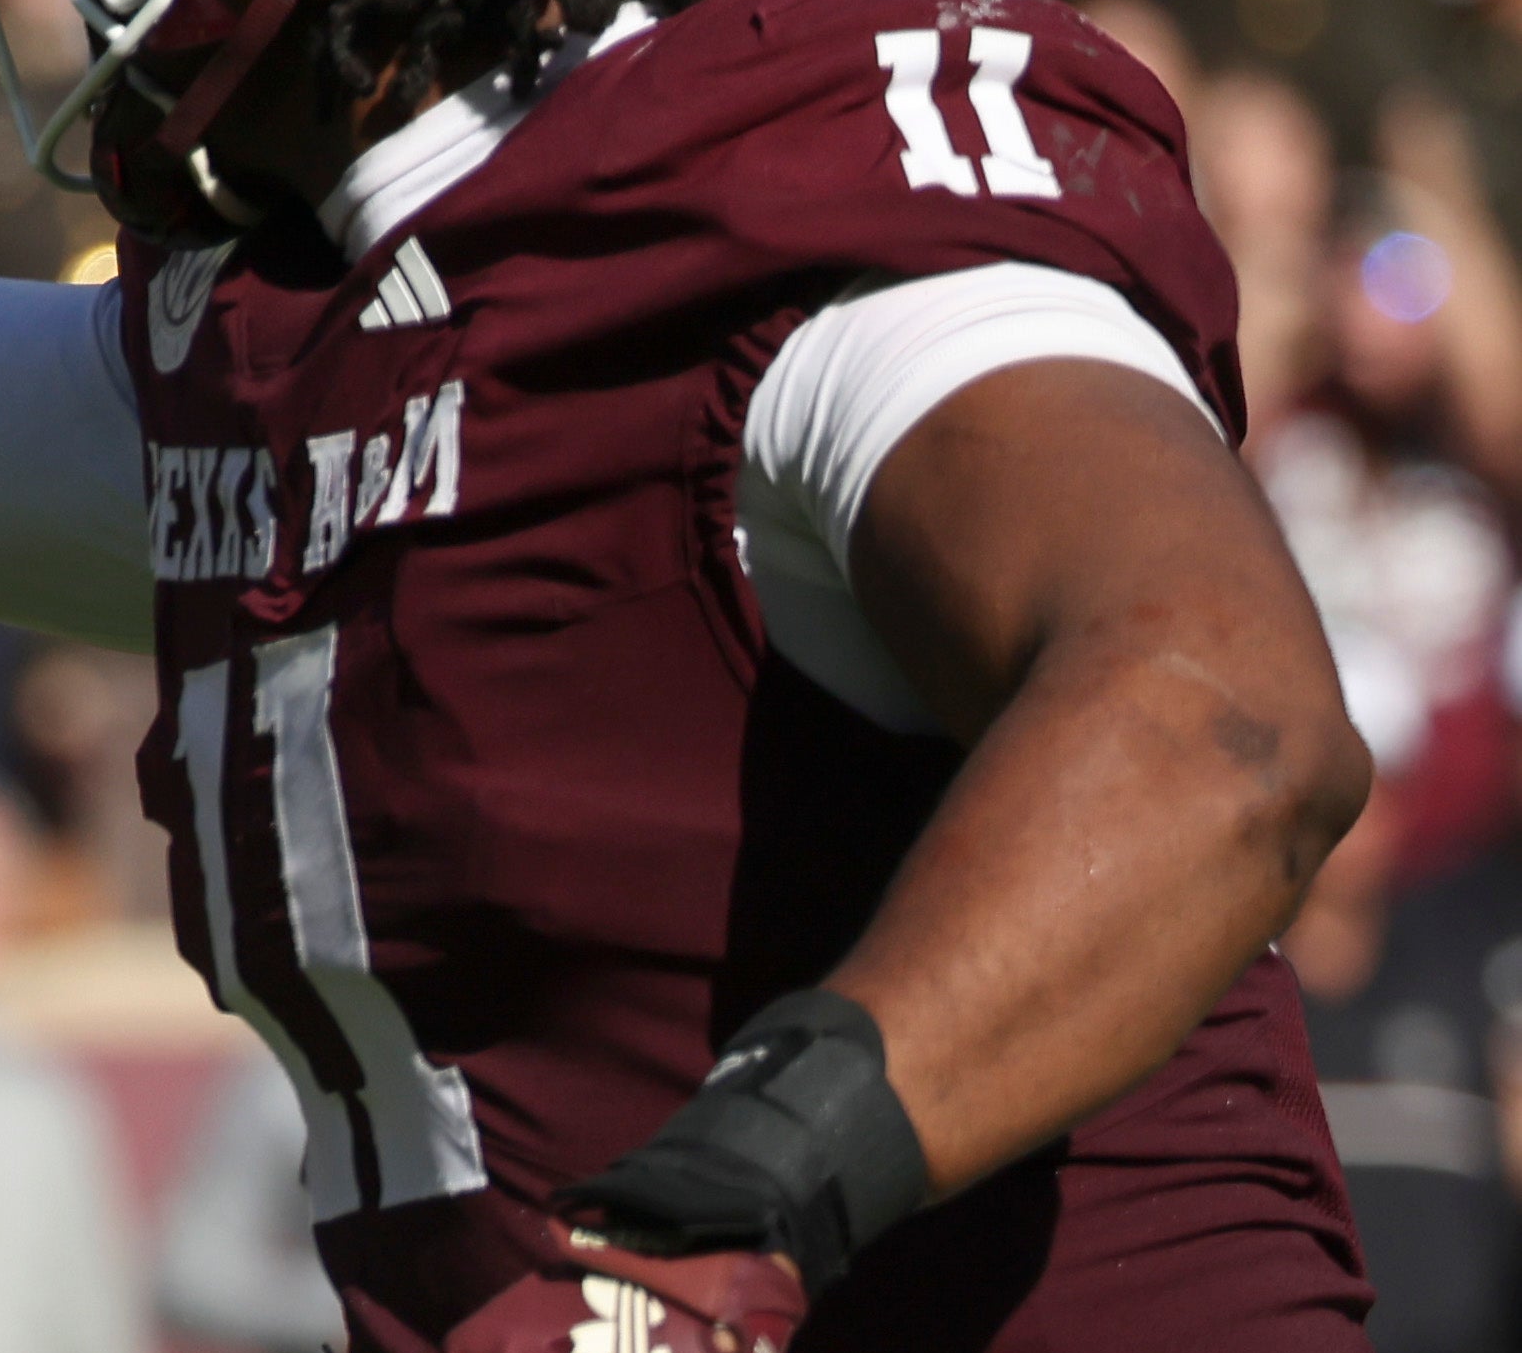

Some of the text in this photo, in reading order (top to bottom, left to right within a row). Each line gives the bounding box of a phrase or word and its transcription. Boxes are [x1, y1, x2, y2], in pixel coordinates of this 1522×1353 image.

[875, 29, 1060, 198] 11
[148, 379, 464, 583] EXAS A&M
[174, 625, 488, 1224] 11
